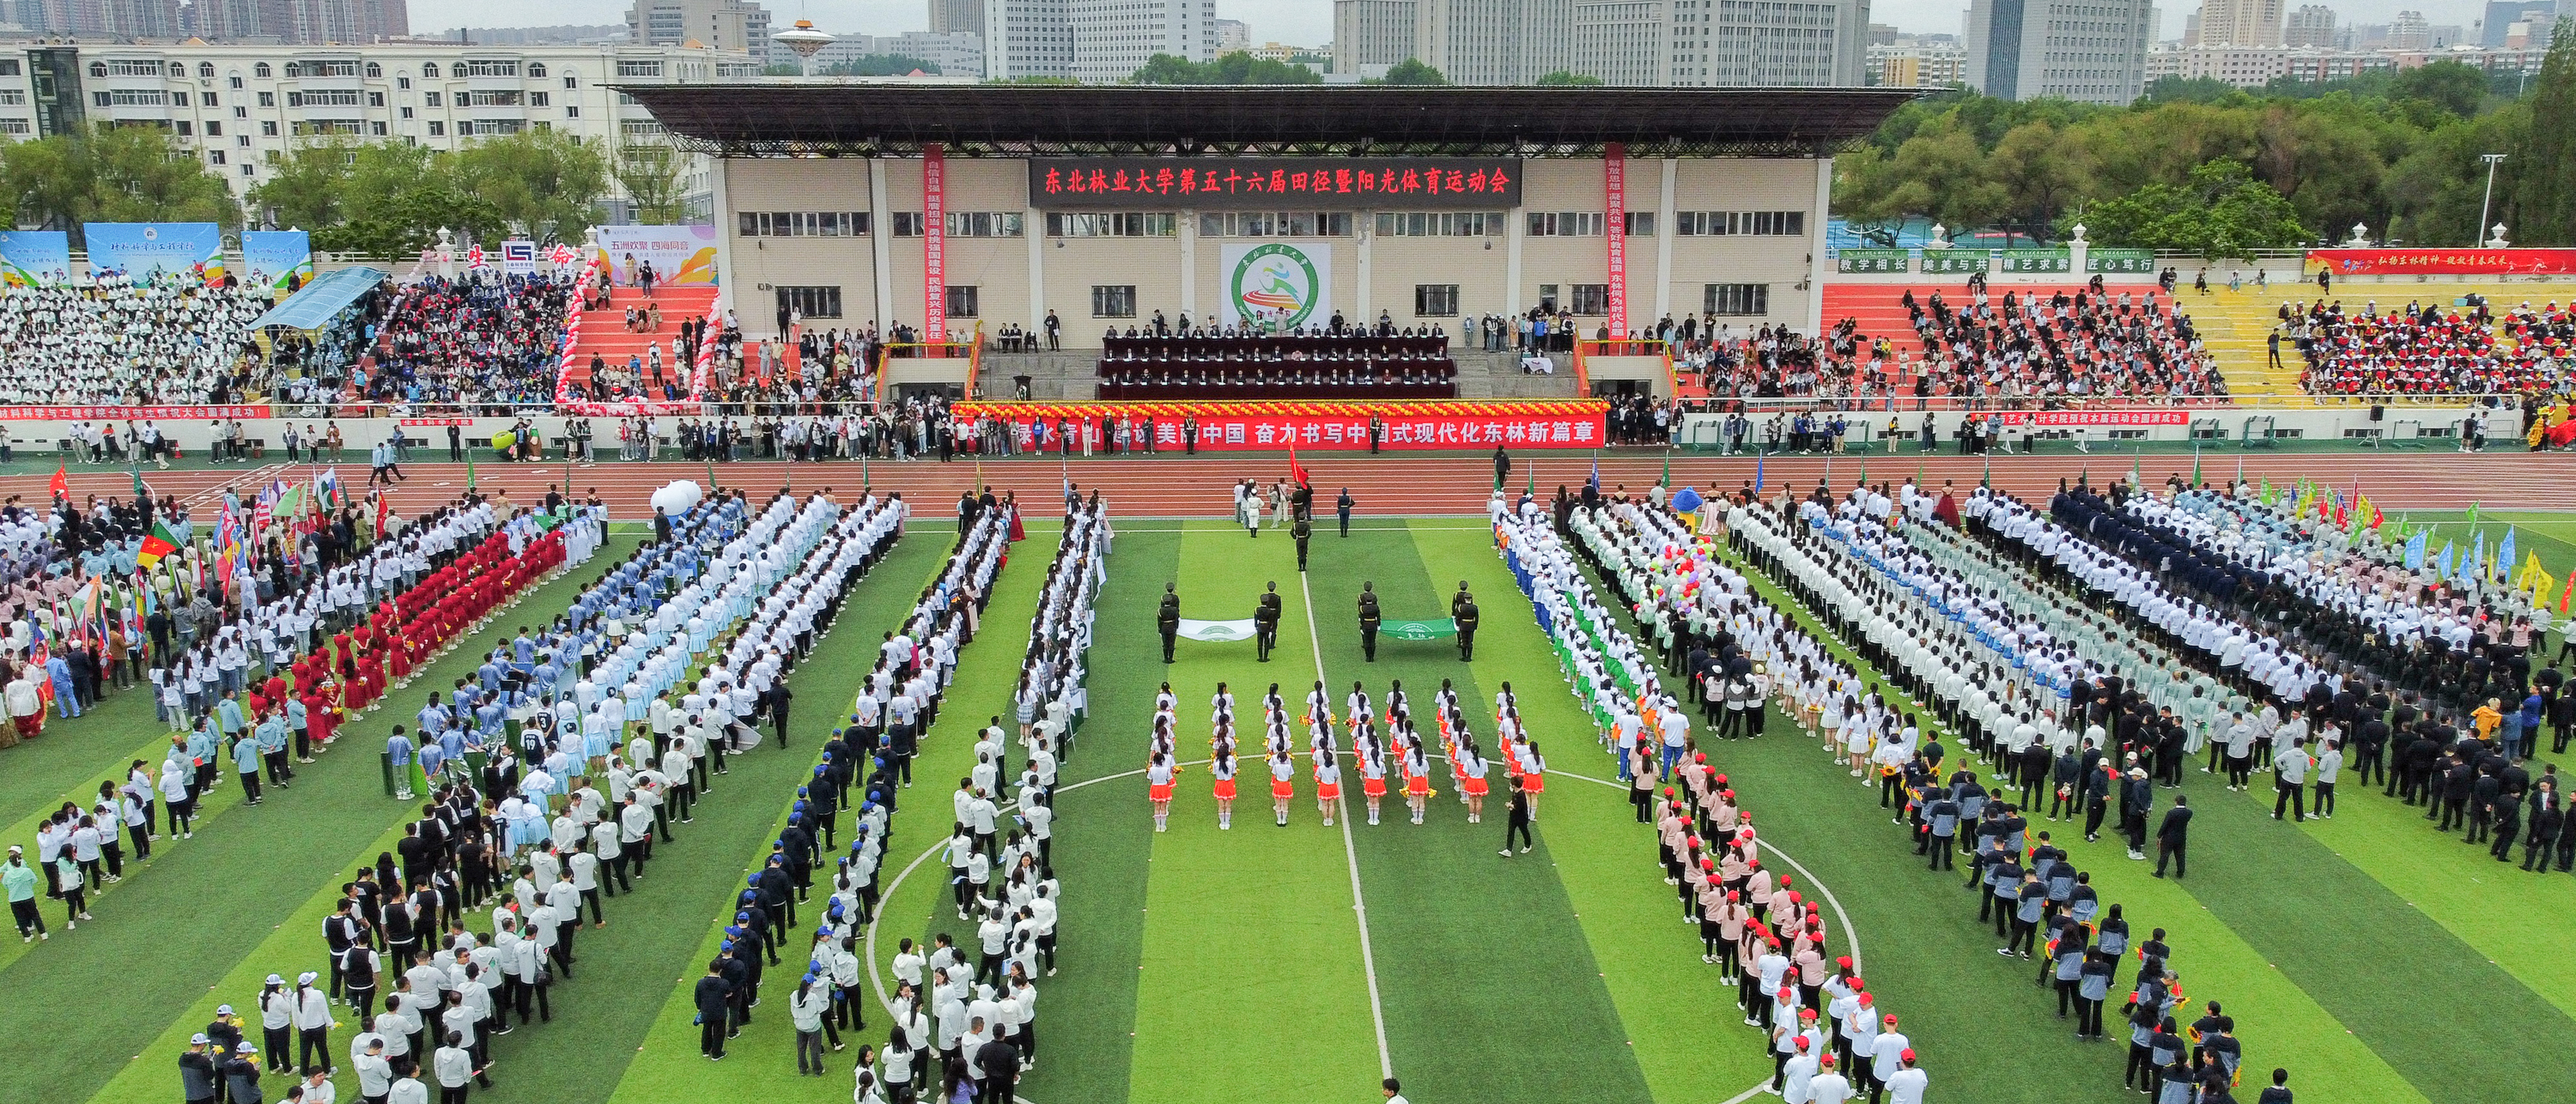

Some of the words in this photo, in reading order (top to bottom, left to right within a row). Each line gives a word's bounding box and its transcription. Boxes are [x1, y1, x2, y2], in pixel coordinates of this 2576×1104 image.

[927, 161, 940, 192] 自信自强
[1044, 167, 1510, 196] 东北林业大学第五十六届田径暨阳光体育运动会
[1607, 160, 1621, 191] 解放思想
[1608, 193, 1622, 224] 凝聚共识
[468, 245, 490, 269] 生
[550, 244, 575, 270] 命
[611, 240, 648, 251] 五洲欢聚
[652, 240, 690, 251] 四海同音
[927, 228, 942, 275] 勇挑强国建设
[1610, 226, 1623, 272] 答好教育强国
[1840, 258, 1906, 270] 教学相长
[1922, 258, 1988, 271] 美美与共
[2003, 258, 2069, 270] 精艺求索
[2087, 258, 2152, 270] 匠心笃行
[927, 277, 943, 340] 民族复兴历史重任
[1611, 275, 1625, 337] 东林何为时代命题
[1985, 413, 2182, 425] 与艺术计学院预祝本届运动会圆满成功
[1255, 422, 1594, 444] 奋力书写中国式现代化东林新篇章
[539, 717, 547, 729] 3
[525, 738, 536, 751] 19
